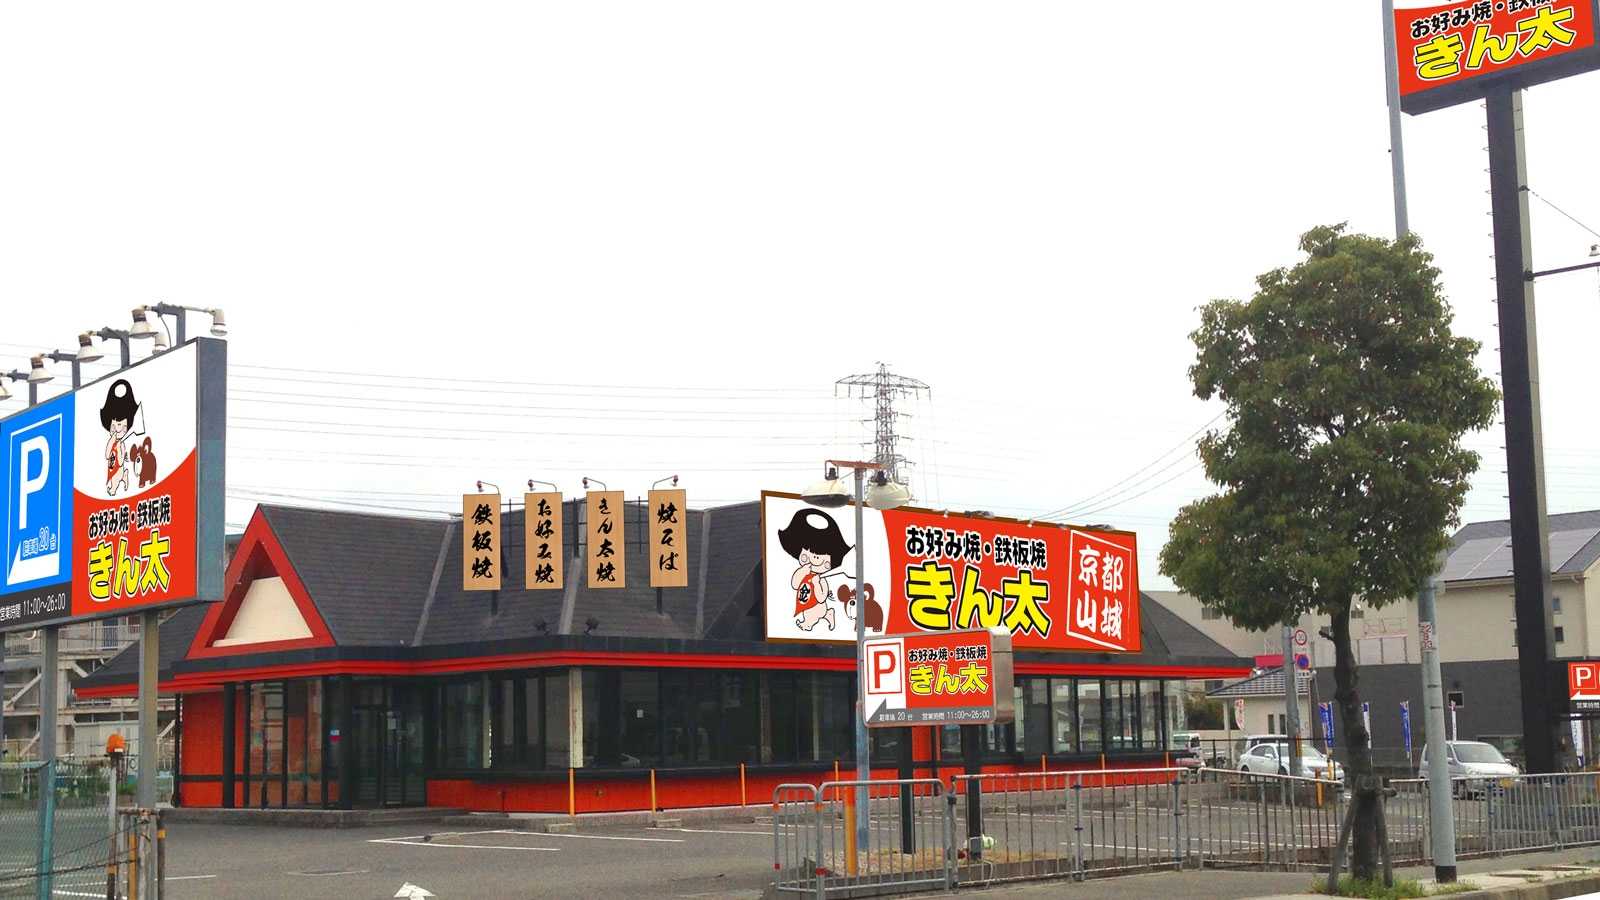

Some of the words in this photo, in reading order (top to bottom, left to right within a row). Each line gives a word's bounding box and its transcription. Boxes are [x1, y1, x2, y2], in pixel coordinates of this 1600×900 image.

[1415, 6, 1576, 79] きん太
[19, 435, 50, 530] P
[88, 496, 171, 538] お好み焼・鉄板焼
[471, 503, 493, 579] 鉄板焼
[534, 499, 555, 584] お好み焼
[596, 498, 616, 582] きん太焼
[657, 503, 679, 572] 焼そば
[88, 530, 170, 601] きん太
[906, 526, 1047, 568] お好み焼・鉄板焼
[1078, 548, 1124, 594] 京都
[906, 561, 1052, 637] きん太
[1076, 592, 1123, 640] 山城
[874, 650, 896, 689] P
[908, 646, 987, 662] お好み焼・鉄板焼
[909, 662, 988, 694] きん太
[1575, 667, 1592, 687] P
